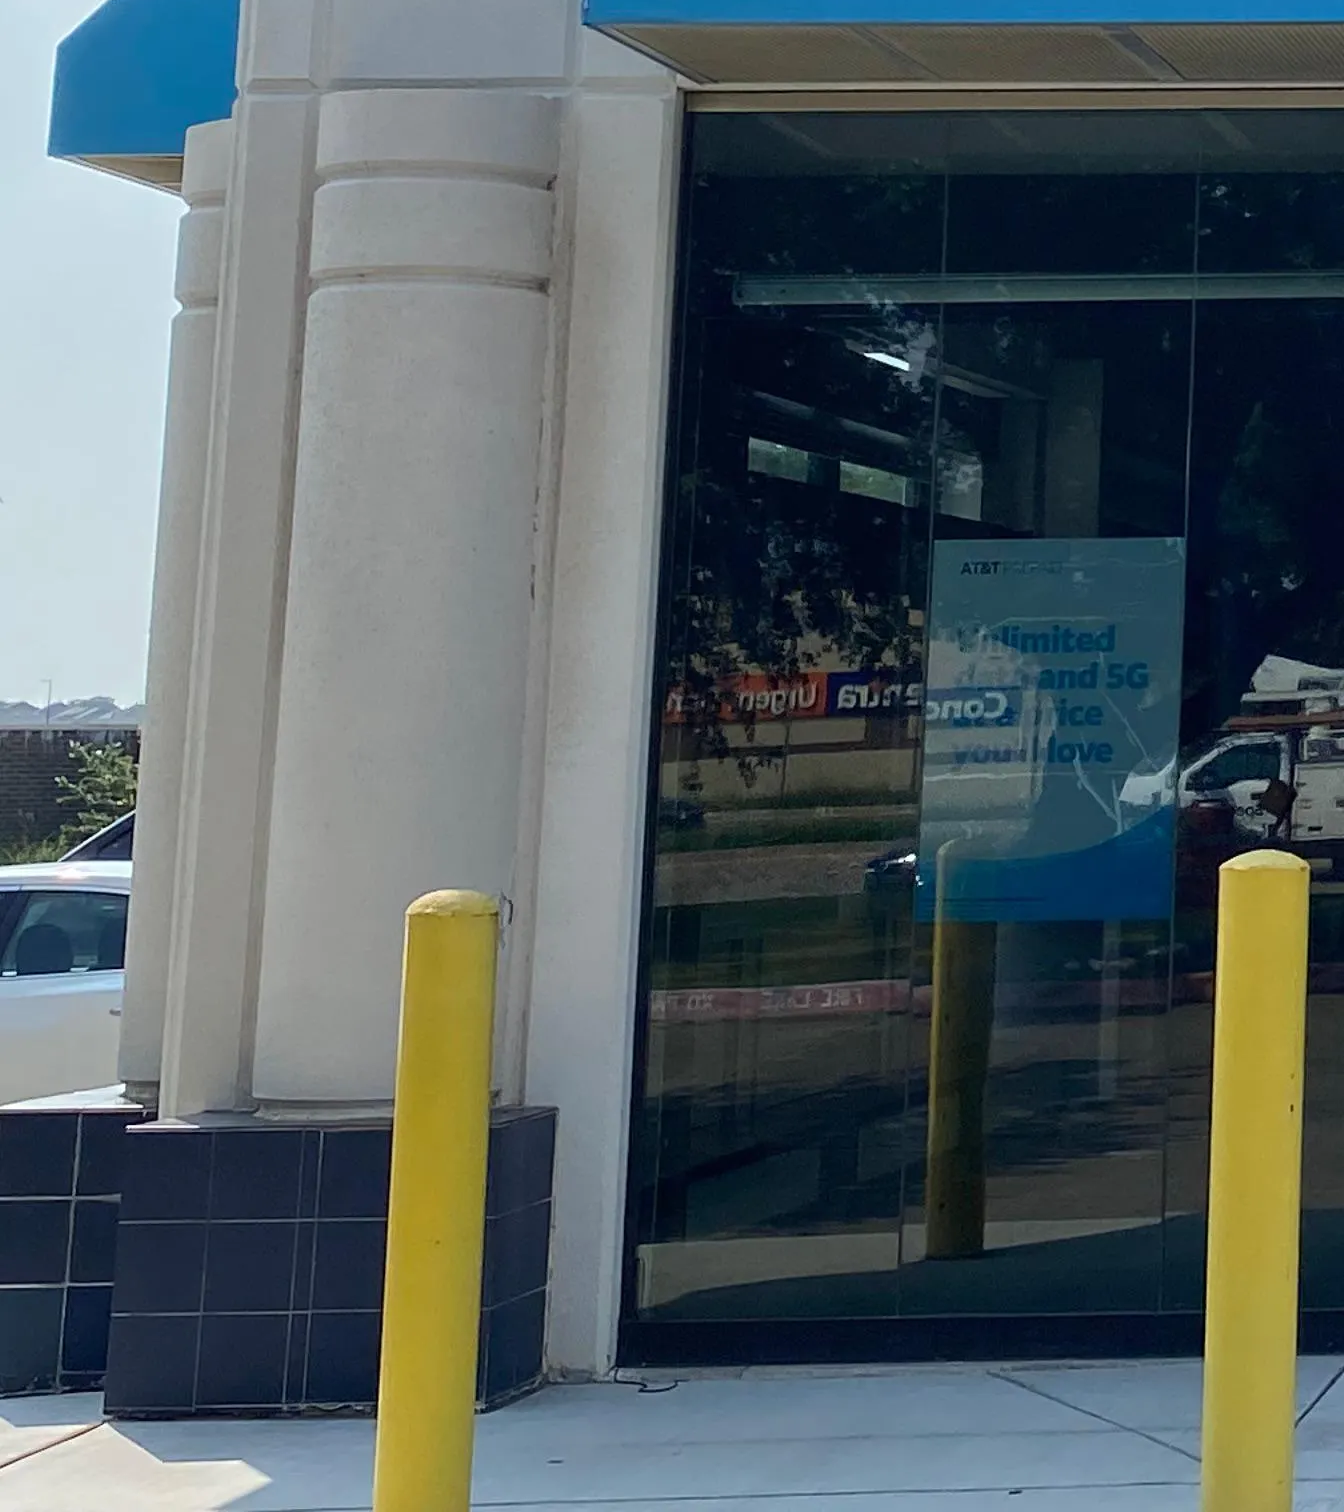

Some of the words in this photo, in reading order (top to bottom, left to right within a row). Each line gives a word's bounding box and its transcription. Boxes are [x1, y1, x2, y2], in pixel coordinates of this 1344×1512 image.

[961, 561, 1000, 575] AT&T
[1039, 662, 1099, 689] and
[1106, 662, 1149, 689] 5G
[1048, 733, 1113, 764] love
